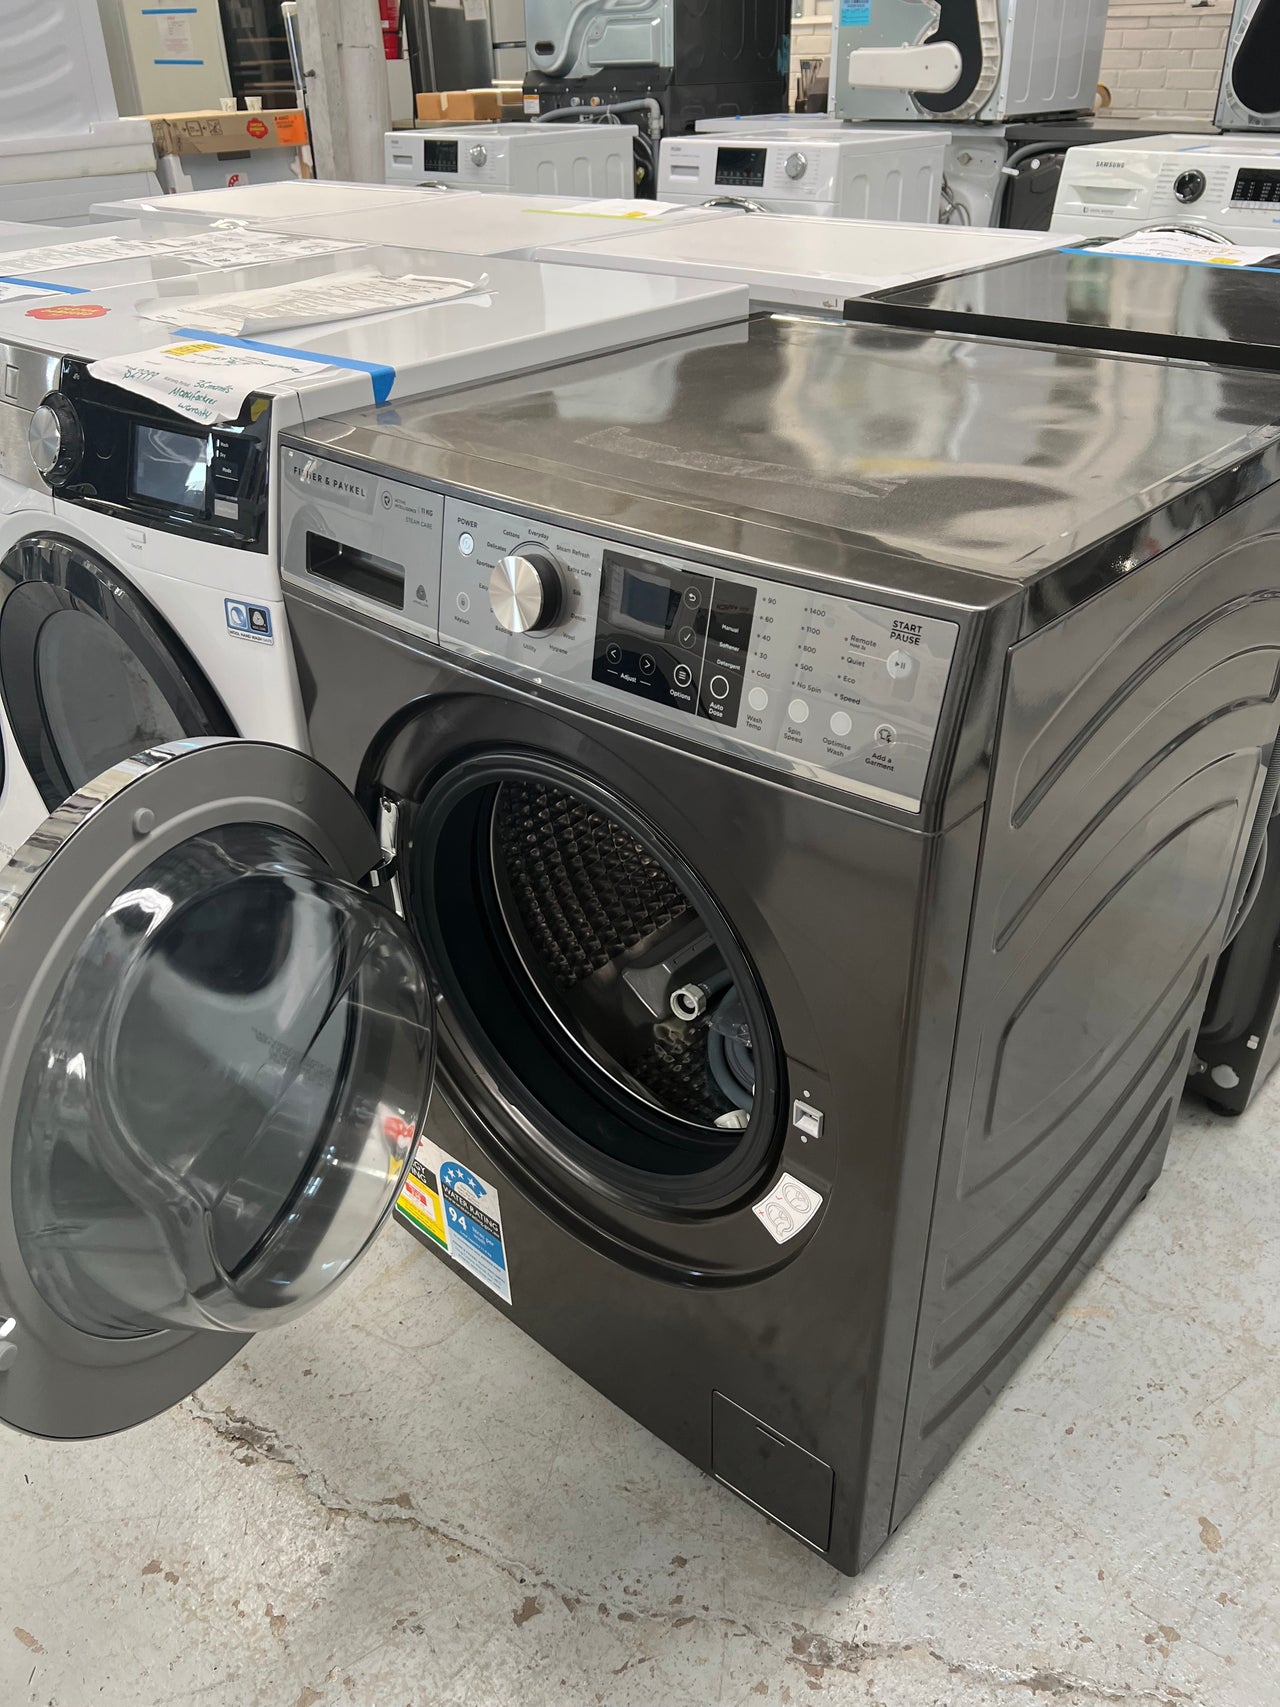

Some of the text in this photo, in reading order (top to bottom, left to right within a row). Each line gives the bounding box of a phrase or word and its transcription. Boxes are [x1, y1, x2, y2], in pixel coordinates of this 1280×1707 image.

[1096, 161, 1125, 169] SAMSUNG
[325, 477, 330, 485] &
[333, 480, 365, 497] PAYKEL
[420, 521, 432, 530] CARE
[457, 517, 478, 529] POWER
[503, 529, 520, 539] Cottons
[528, 529, 549, 541] Everyday
[487, 541, 507, 552] Delicates
[556, 544, 590, 559] Steam Refresh
[567, 565, 592, 578] Extra Care
[767, 597, 777, 605] 90
[809, 607, 826, 617] 1400
[765, 616, 774, 624] 60
[721, 624, 739, 633] Manual
[806, 626, 821, 636] 1100
[892, 620, 923, 634] START
[563, 632, 575, 641] Wool
[762, 634, 771, 642] 40
[850, 634, 877, 648] Remote
[890, 631, 921, 646] PAUSE
[523, 643, 537, 653] Utility
[719, 642, 740, 652] Softener
[803, 645, 817, 654] 800
[759, 652, 768, 660] 30
[716, 659, 741, 670] Detergent
[846, 656, 865, 668] Quiet
[800, 663, 813, 672] 500
[620, 672, 637, 683] Adjust
[756, 670, 771, 680] Cold
[843, 675, 856, 684] Eco
[796, 681, 822, 694] No Spin
[669, 689, 691, 701] Options
[839, 693, 861, 705] Speed
[709, 702, 724, 712] Auto
[708, 708, 723, 718] Dose
[746, 714, 763, 724] Wash
[745, 721, 762, 731] Temp
[787, 726, 801, 736] Spin
[783, 733, 803, 744] Speed
[822, 737, 851, 751] Optimise
[826, 746, 844, 757] Wash
[872, 752, 887, 762] Add
[865, 757, 894, 772] Garment
[442, 1182, 470, 1209] WATER
[469, 1204, 499, 1232] RATING
[449, 1206, 467, 1231] 94
